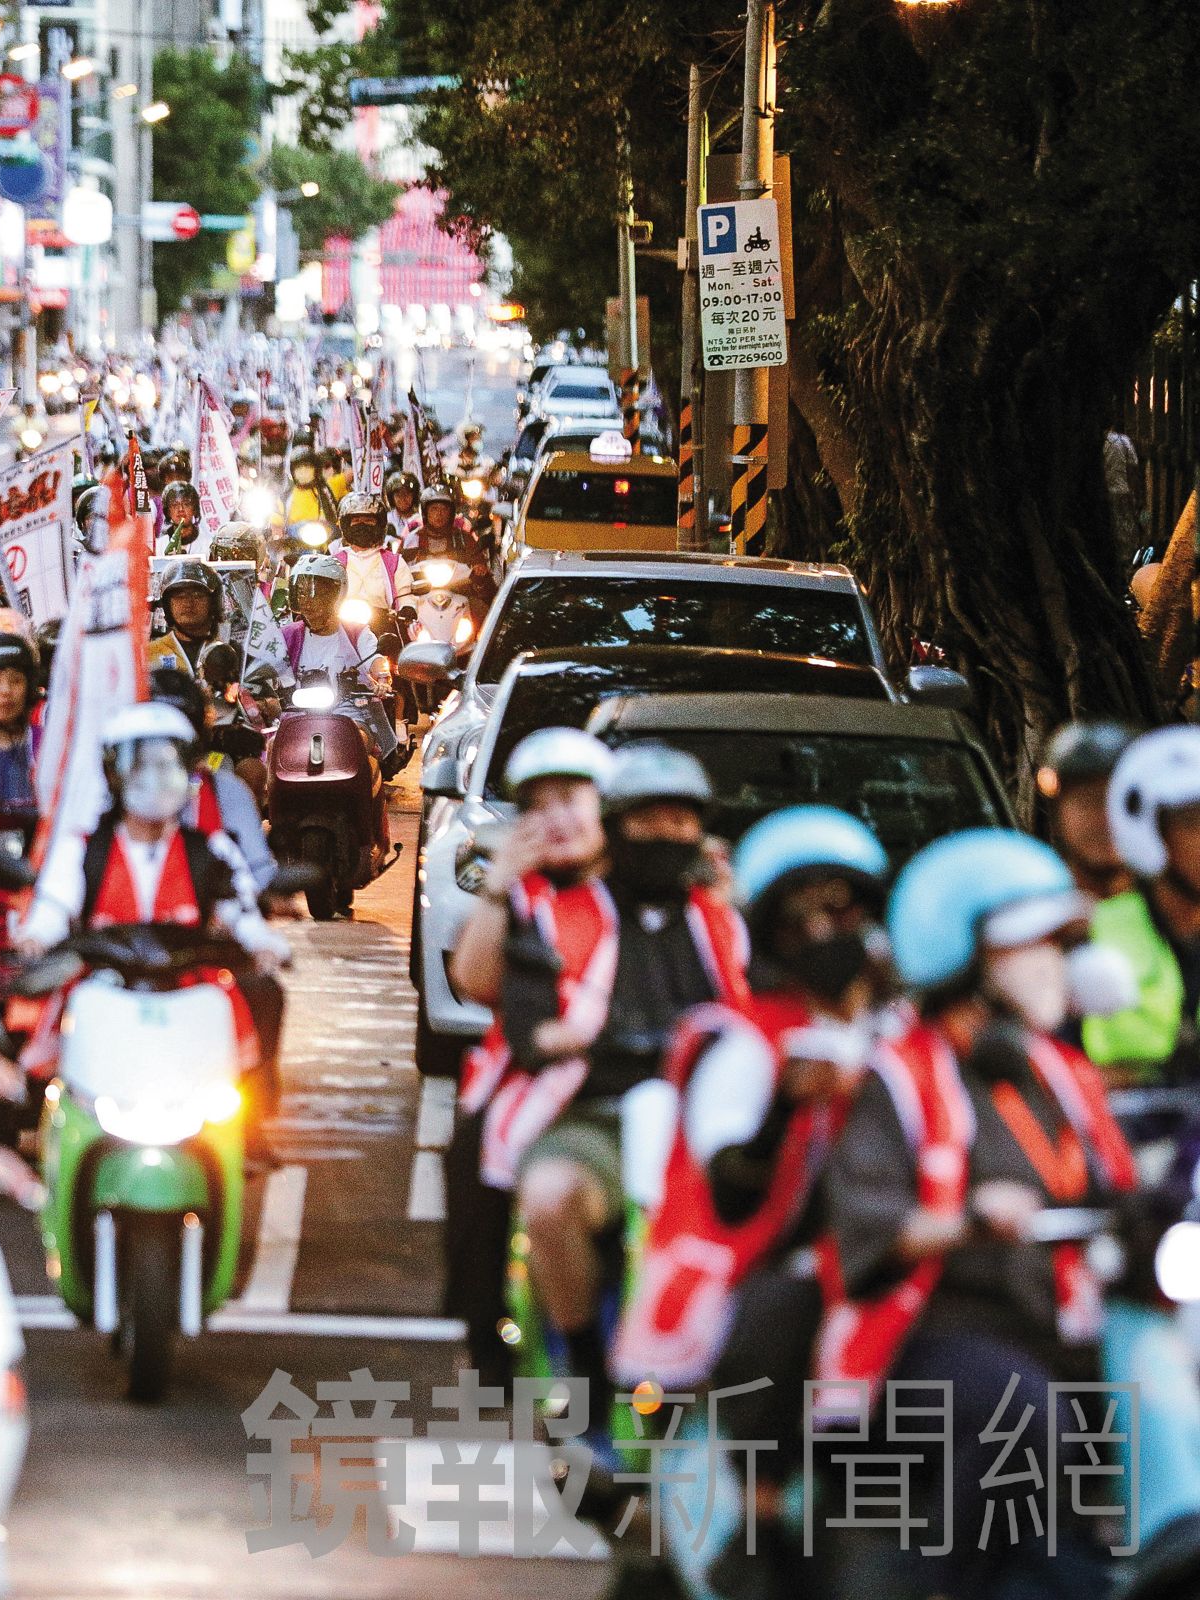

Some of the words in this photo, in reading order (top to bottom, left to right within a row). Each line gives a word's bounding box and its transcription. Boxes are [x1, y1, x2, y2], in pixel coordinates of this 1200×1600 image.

[707, 214, 730, 248] P
[702, 259, 779, 279] 週一至週六
[708, 282, 734, 291] Mon.
[753, 277, 775, 287] Sat.
[702, 291, 781, 308] 09:00-17:00
[711, 307, 777, 325] 每次20元
[725, 351, 783, 364] 27269600
